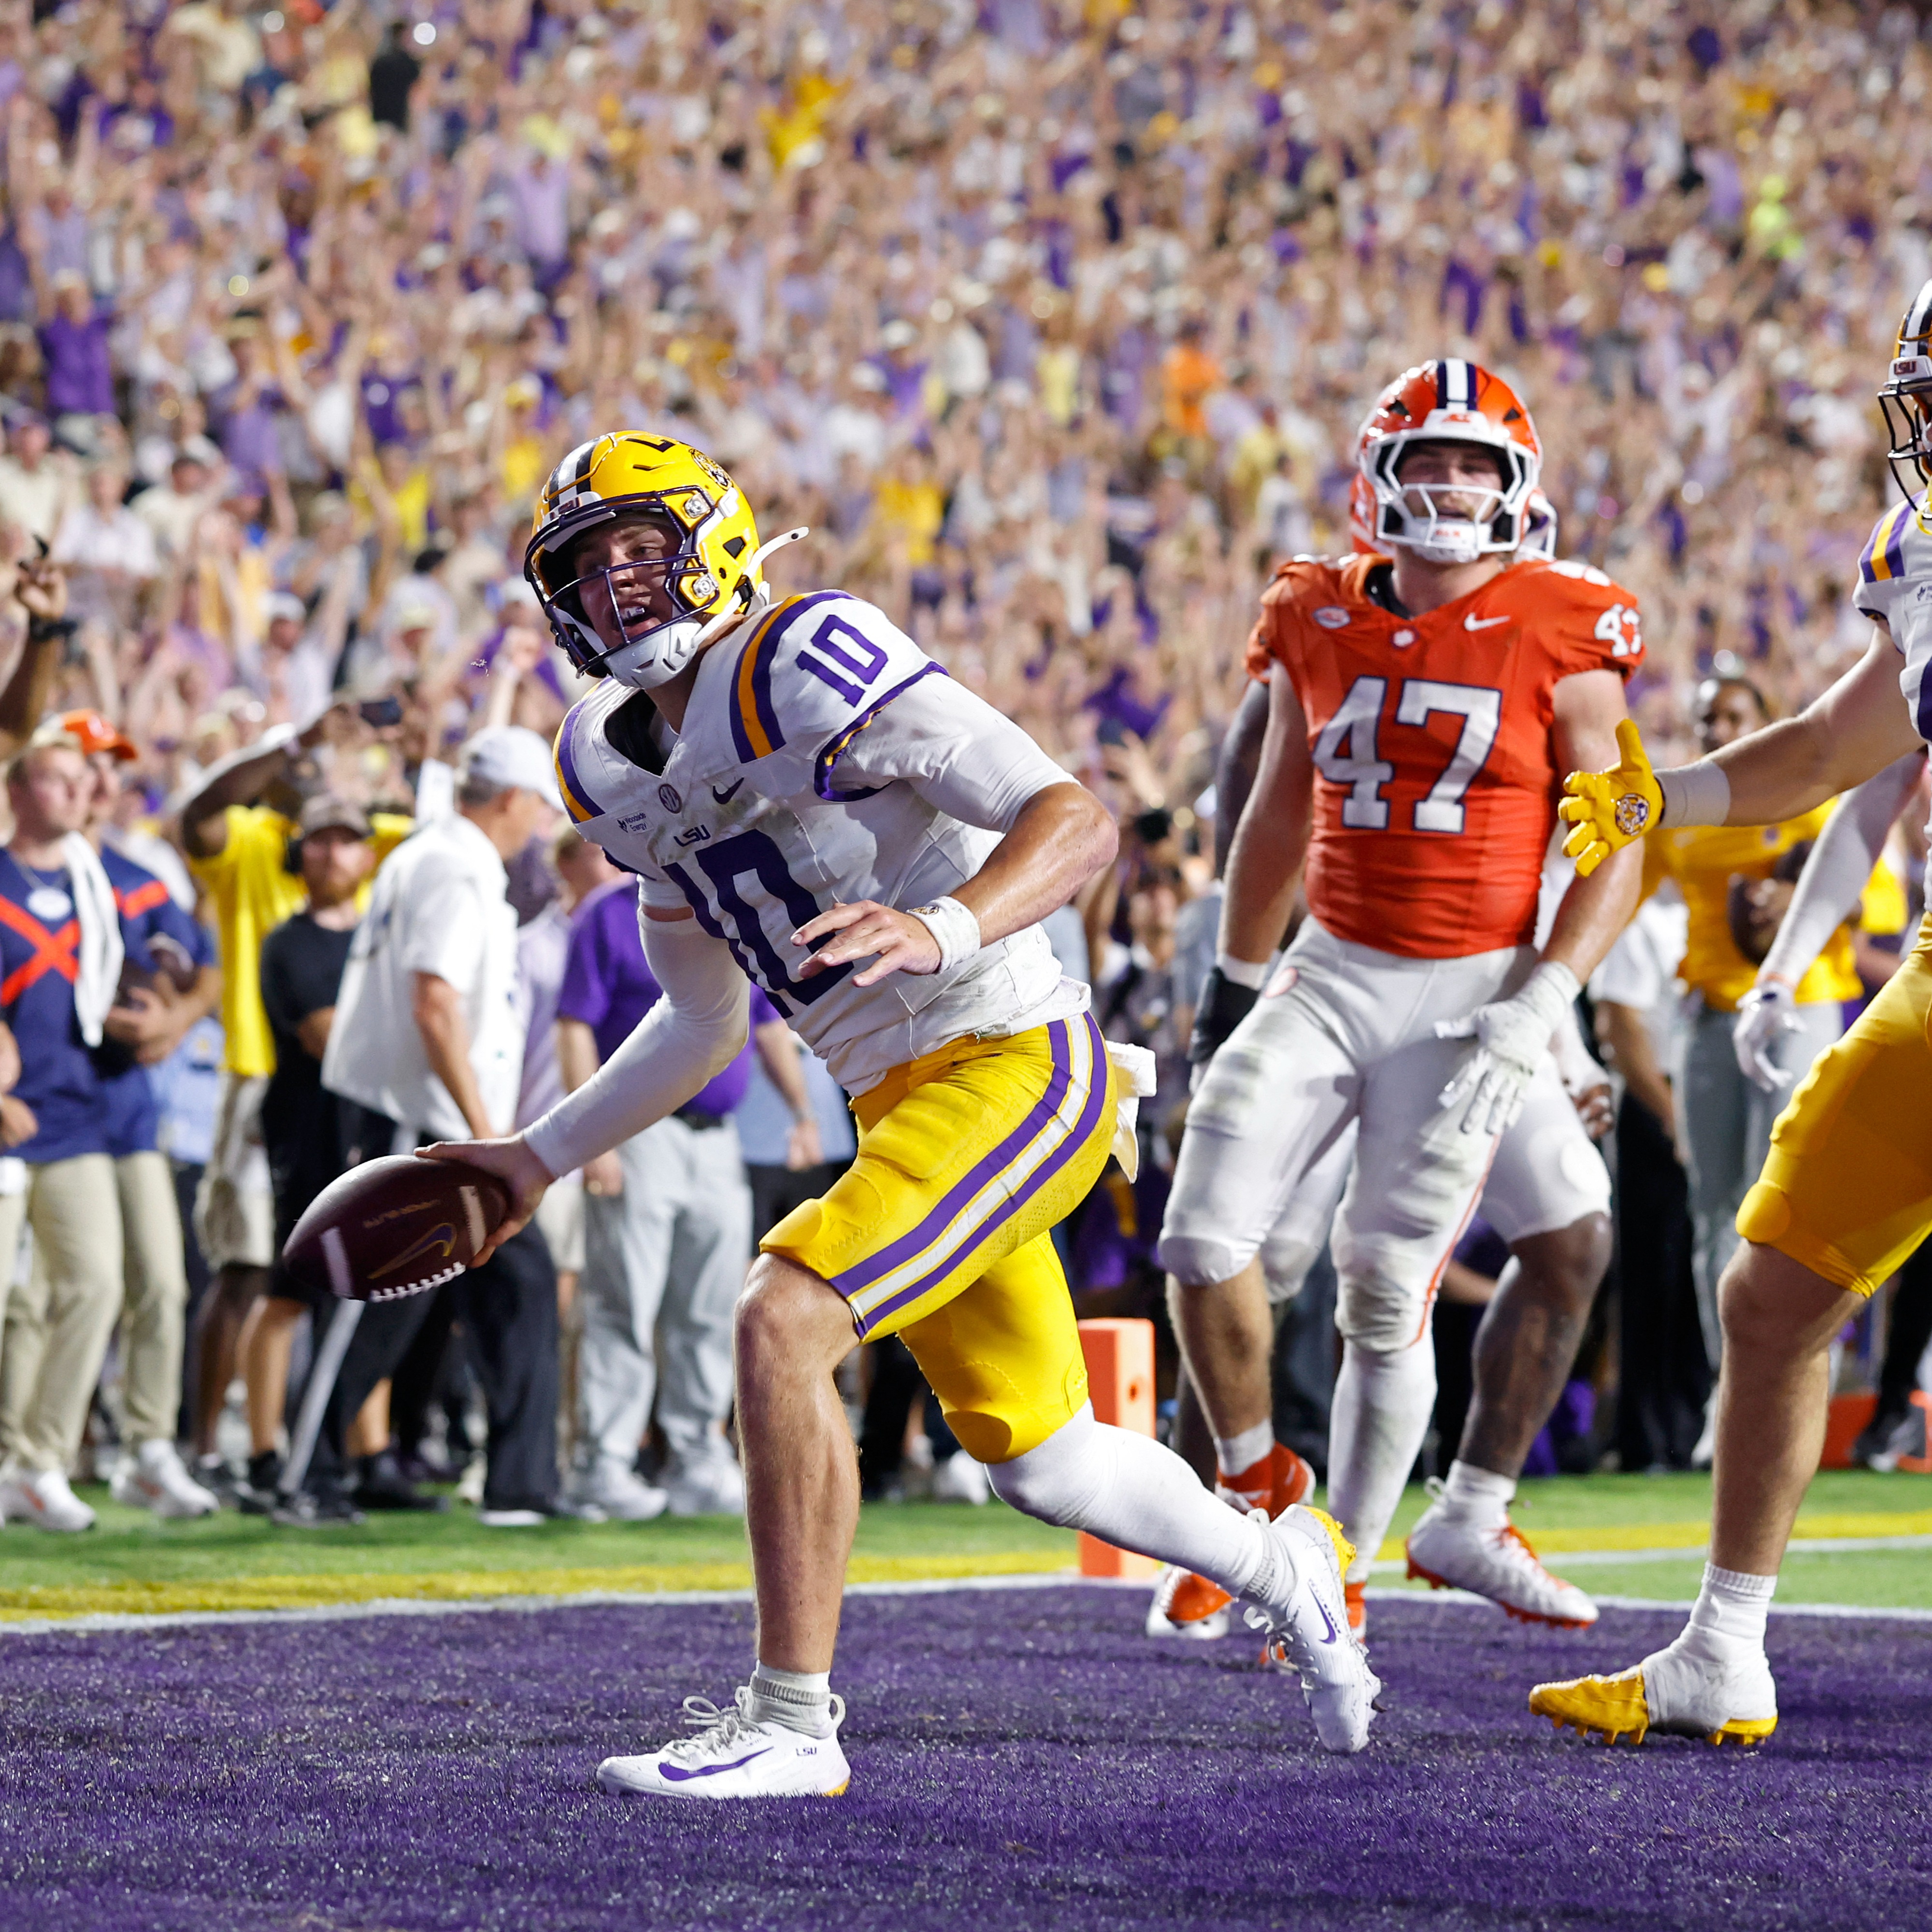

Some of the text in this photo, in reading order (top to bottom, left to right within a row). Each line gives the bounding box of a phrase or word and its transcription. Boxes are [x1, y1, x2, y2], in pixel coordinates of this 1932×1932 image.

[1594, 603, 1642, 657] 47
[796, 614, 888, 708] 10
[1312, 675, 1502, 834] 47
[624, 812, 646, 824] Woodside
[630, 823, 647, 831] Energy
[673, 824, 711, 847] LSU
[661, 828, 854, 1018] 10
[796, 1747, 816, 1756] LSU
